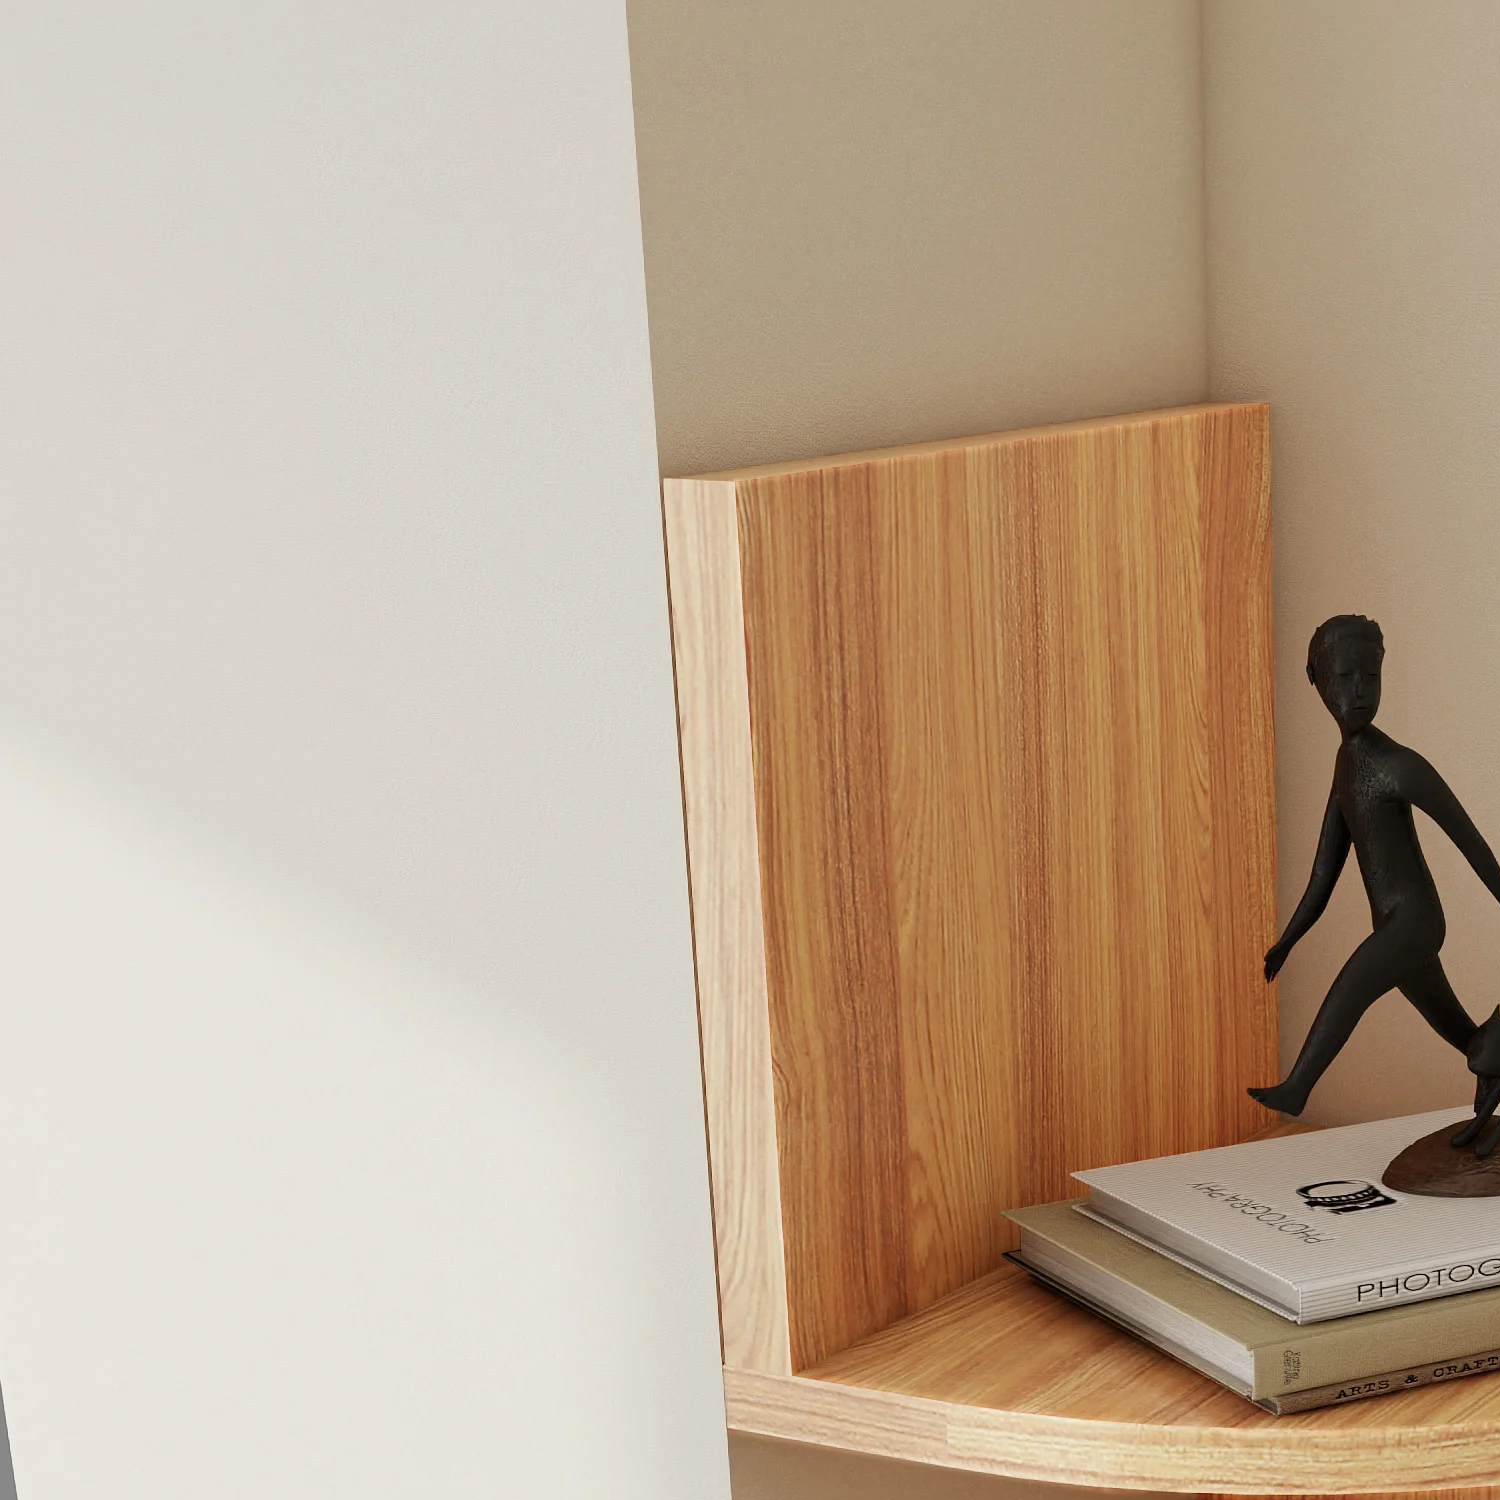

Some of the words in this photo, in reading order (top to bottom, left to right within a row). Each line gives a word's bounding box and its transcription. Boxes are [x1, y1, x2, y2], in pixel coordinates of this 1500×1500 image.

[1187, 1181, 1334, 1244] PHOTOGRAPHY
[1335, 1379, 1391, 1400] ARTS
[1404, 1374, 1419, 1384] &
